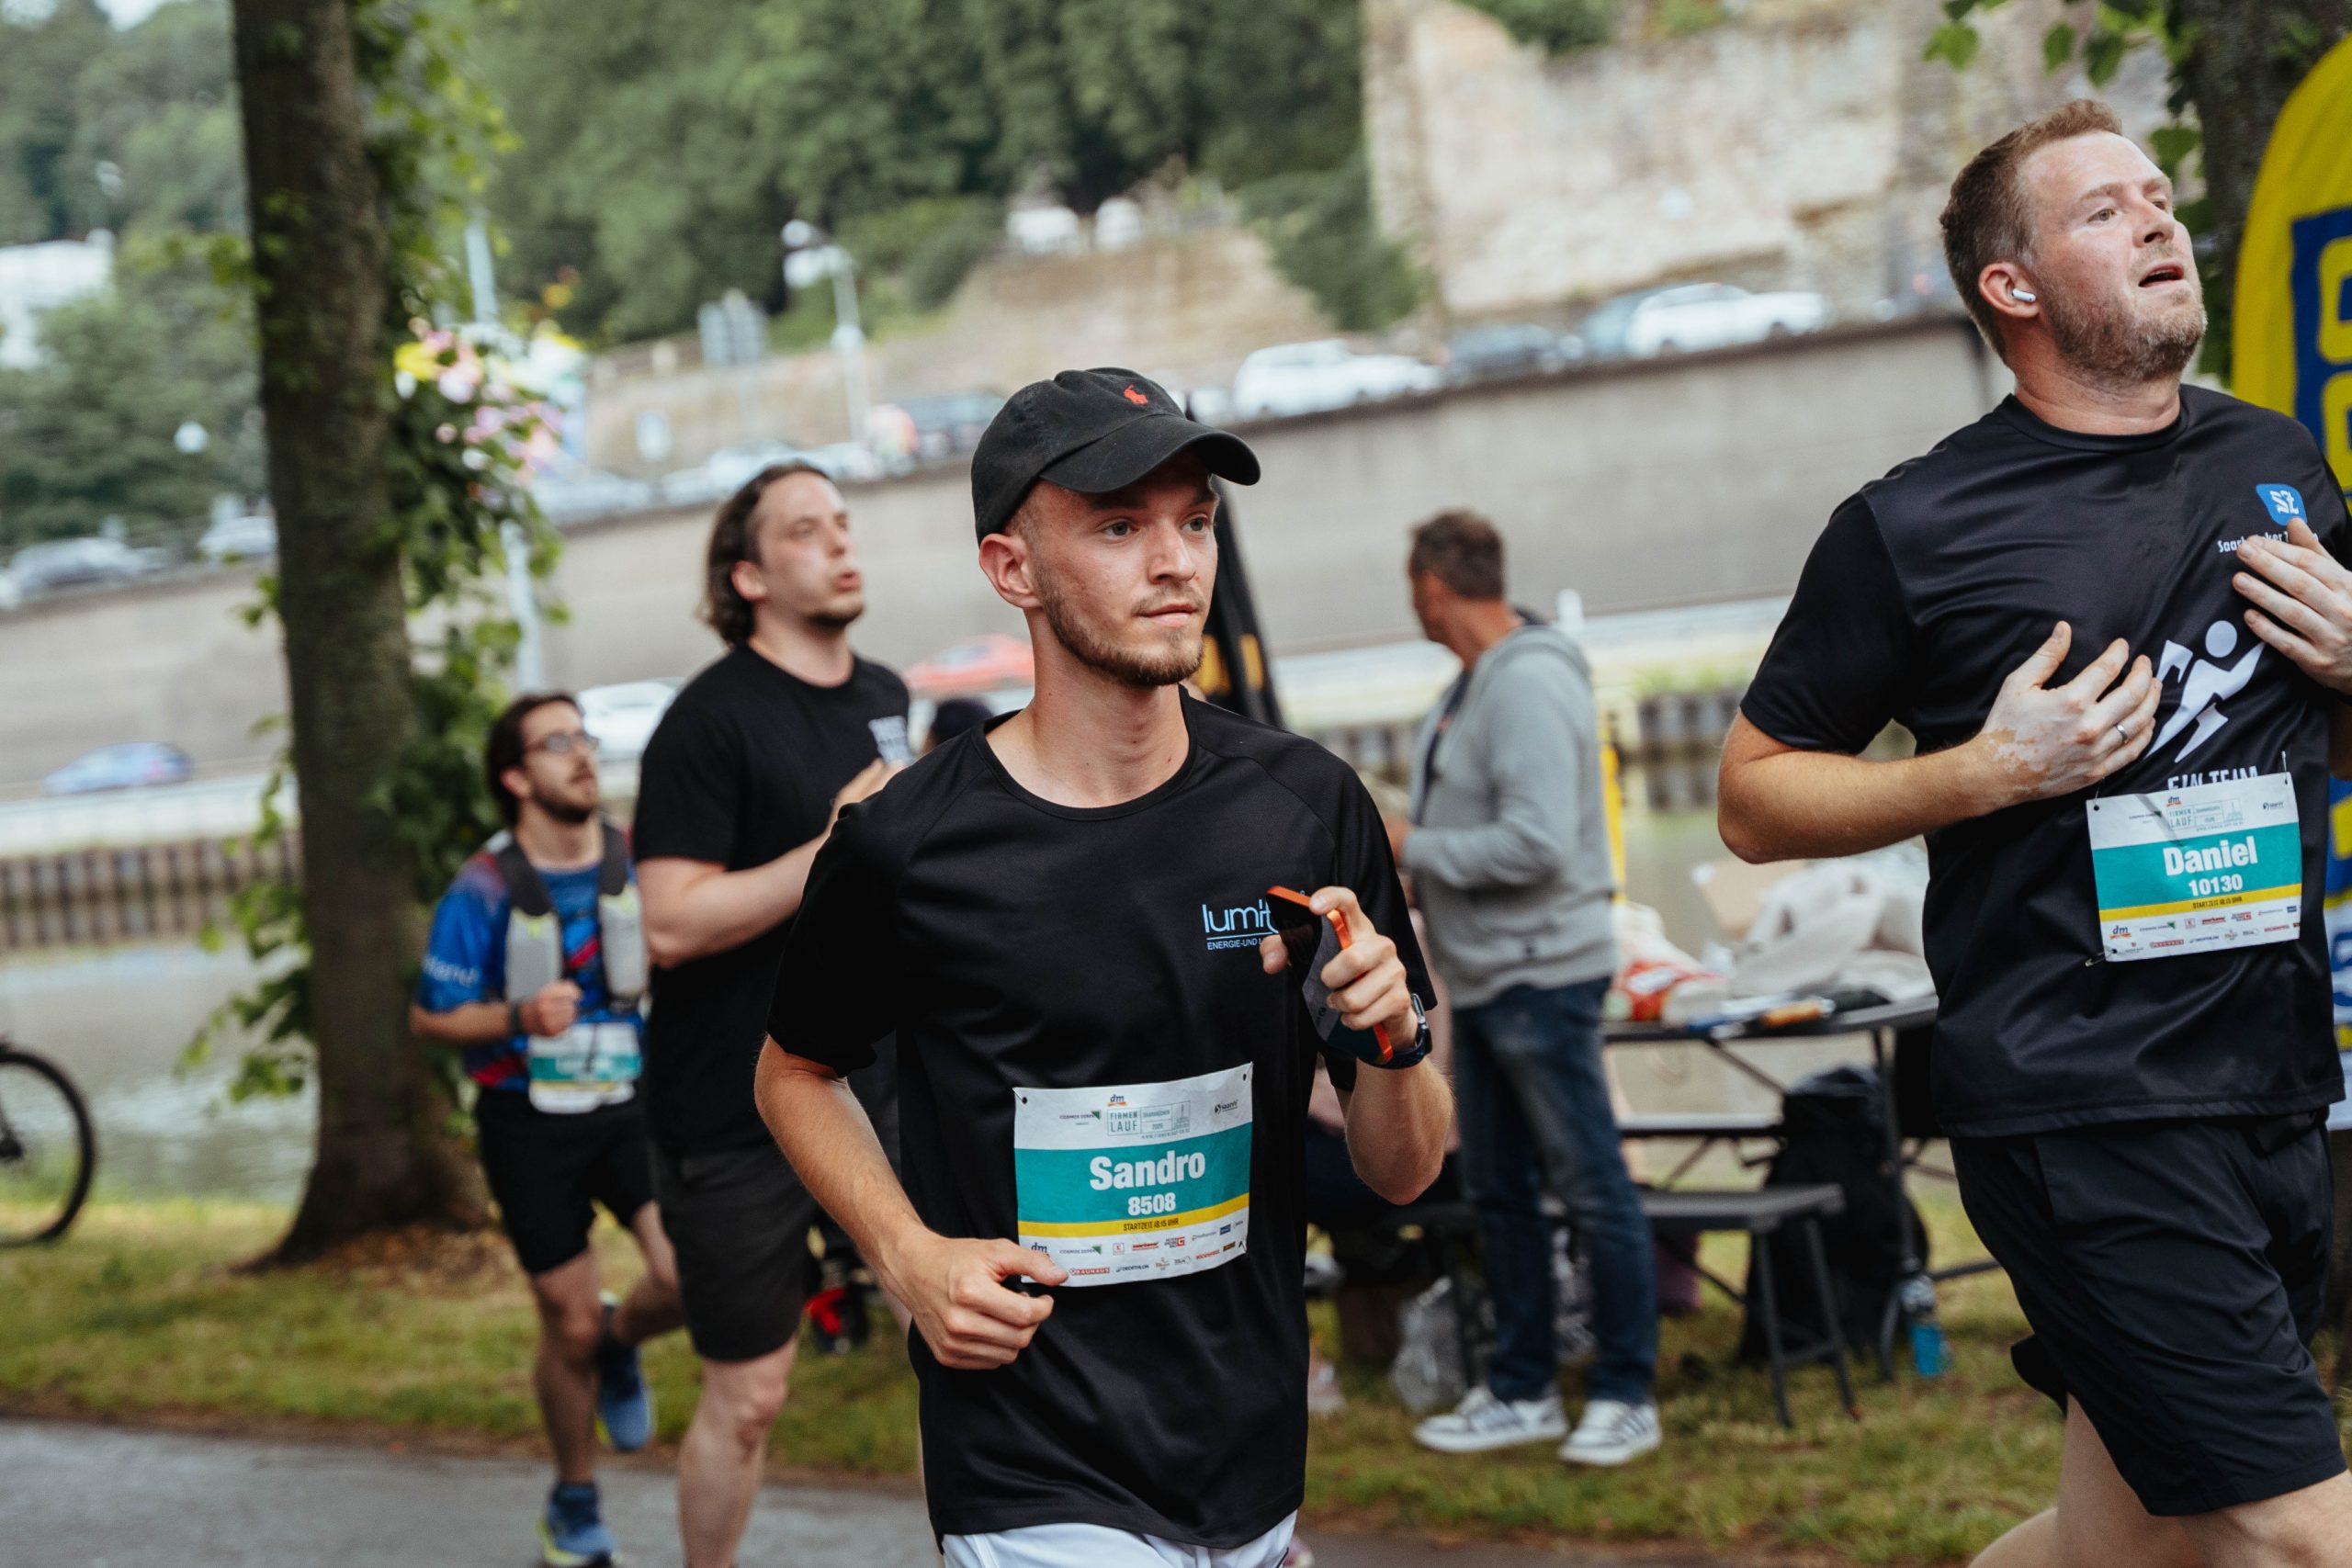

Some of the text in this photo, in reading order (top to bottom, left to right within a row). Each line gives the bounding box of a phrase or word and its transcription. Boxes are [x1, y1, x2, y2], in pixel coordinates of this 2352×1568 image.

[2169, 808, 2191, 817] FIRMEN
[2170, 817, 2192, 828] LAUF
[2163, 835, 2258, 876] Daniel
[2188, 874, 2244, 897] 10130
[2112, 925, 2129, 935] dm
[1110, 1093, 1125, 1103] dm
[1110, 1111, 1138, 1120] FIRMEN
[1110, 1120, 1138, 1134] LAUF
[1090, 1150, 1206, 1191] Sandro
[1127, 1192, 1177, 1216] 8508
[1123, 1221, 1153, 1232] STARTZEIT
[1031, 1242, 1048, 1254] dm
